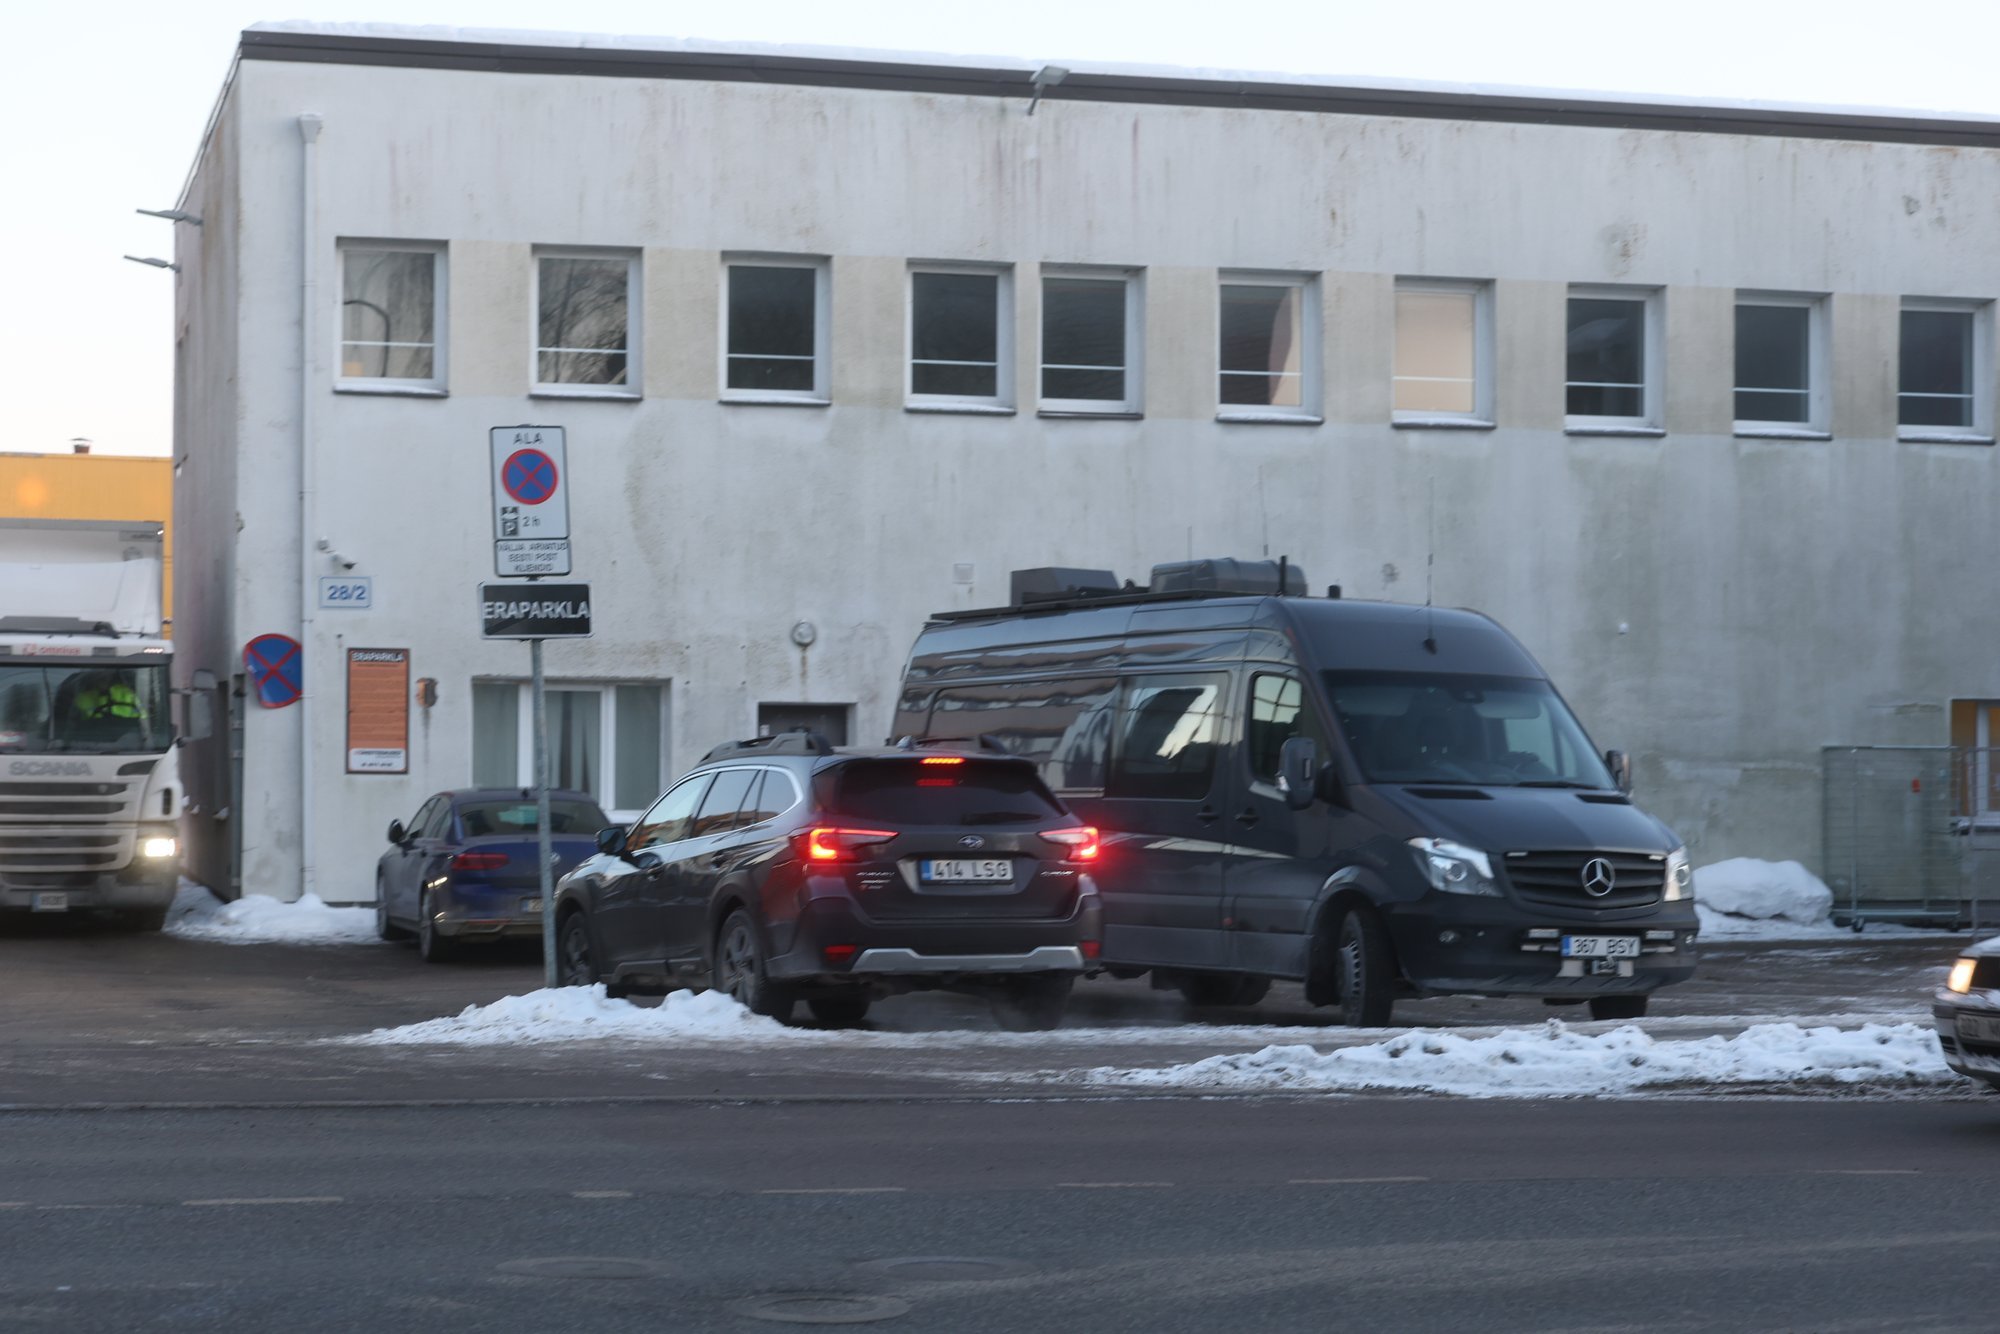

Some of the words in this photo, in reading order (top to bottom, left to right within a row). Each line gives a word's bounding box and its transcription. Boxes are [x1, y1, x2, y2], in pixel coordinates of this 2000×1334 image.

[513, 432, 543, 445] ALA
[522, 516, 530, 527] 2
[535, 552, 558, 562] POST
[327, 584, 366, 600] 28/2
[483, 601, 590, 620] ERAPARKLA
[8, 761, 94, 776] SCANIA
[934, 861, 963, 878] 414
[971, 861, 1009, 878] LSG
